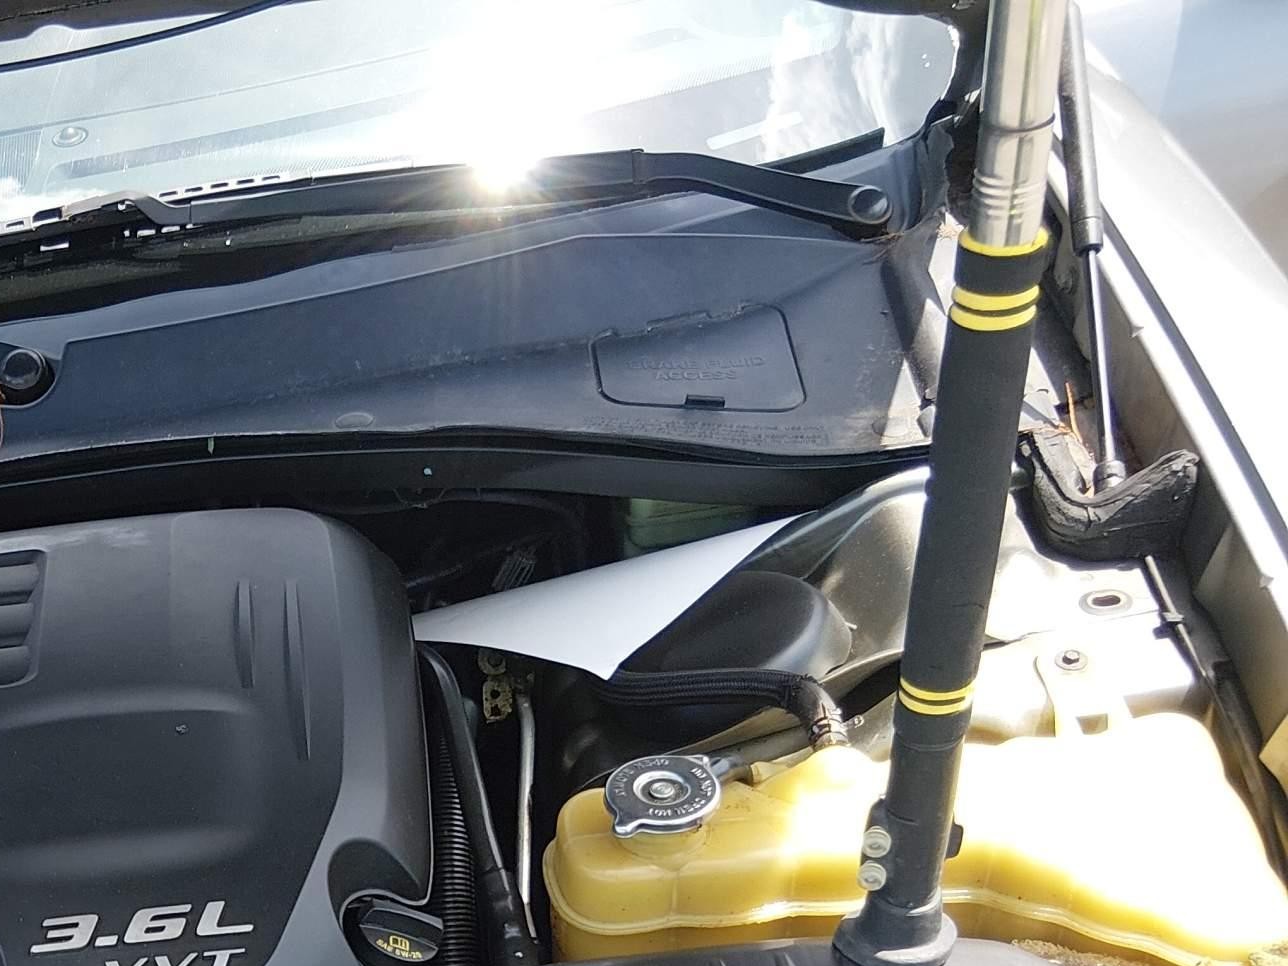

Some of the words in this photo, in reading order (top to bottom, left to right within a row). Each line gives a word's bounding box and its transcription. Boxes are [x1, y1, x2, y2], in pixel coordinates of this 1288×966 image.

[704, 355, 767, 370] FLUID
[655, 370, 737, 381] ACCESS
[29, 900, 254, 955] 3.6L
